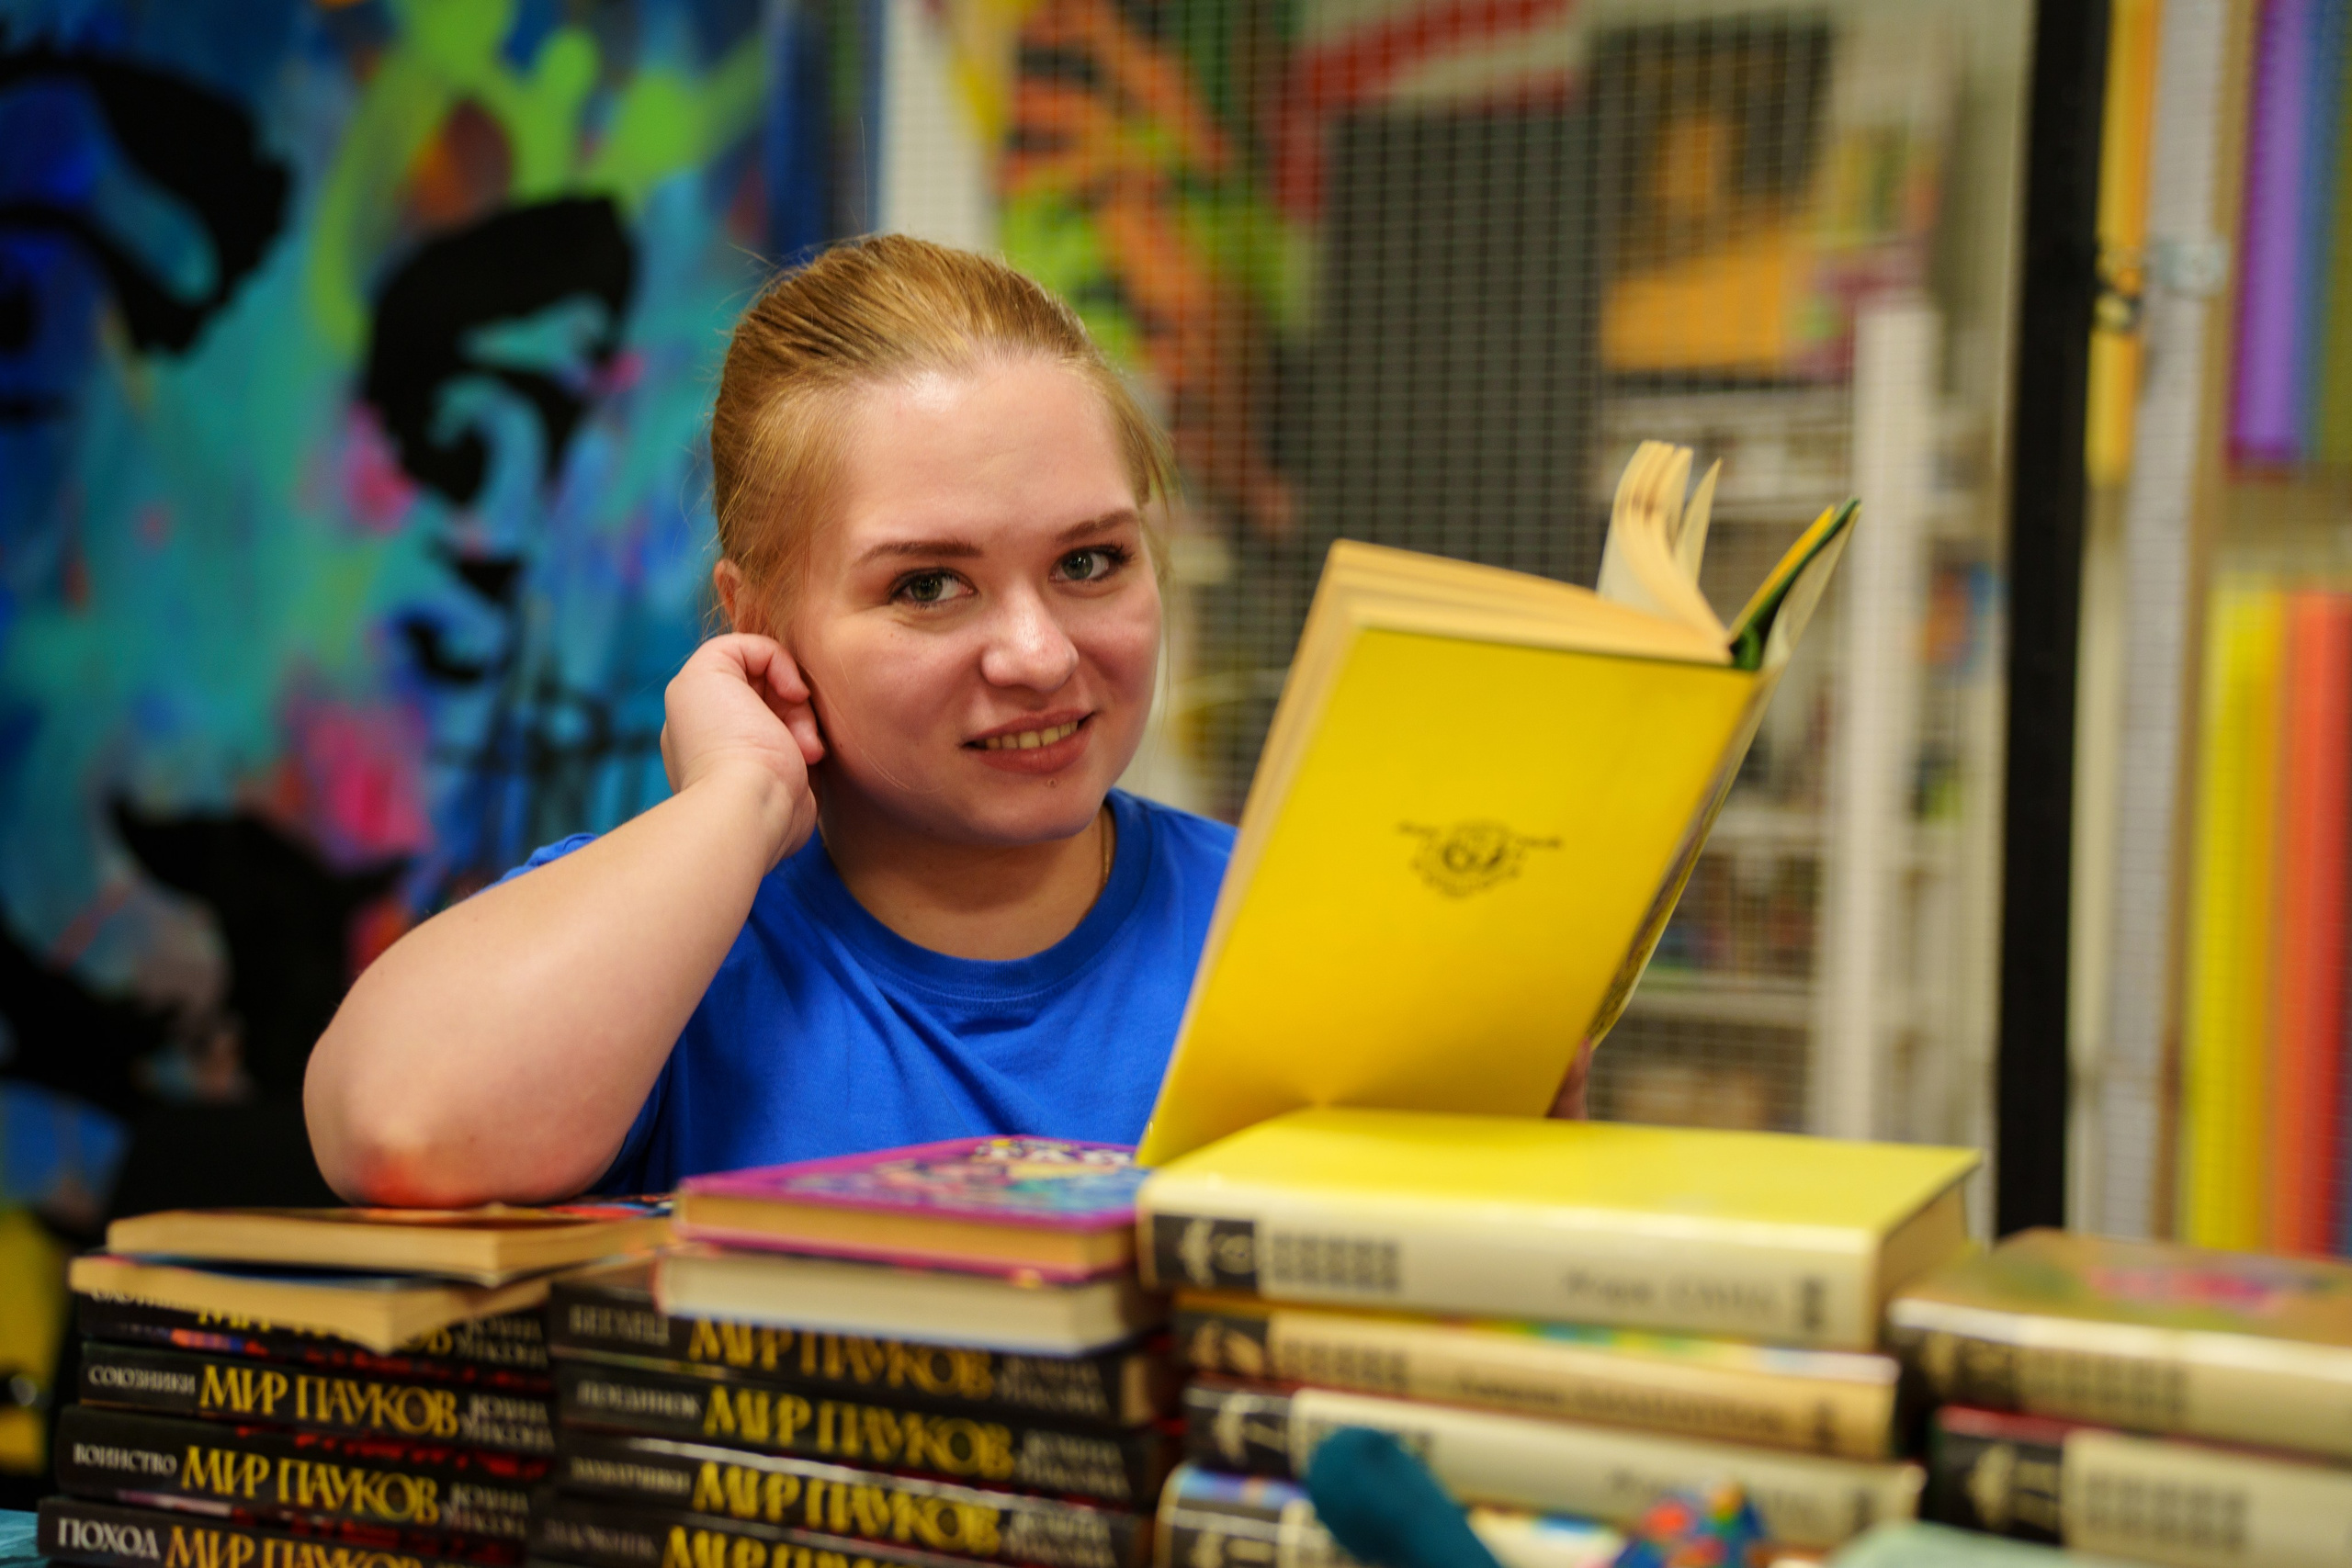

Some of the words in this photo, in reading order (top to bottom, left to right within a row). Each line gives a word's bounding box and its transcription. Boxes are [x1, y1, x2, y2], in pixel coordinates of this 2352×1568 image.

[198, 1363, 289, 1416] МИР
[295, 1373, 460, 1439] ПАУКОВ
[702, 1384, 813, 1445] МИР
[816, 1398, 1013, 1481] ПАУКОВ
[72, 1441, 179, 1478] ВОИНСТВО
[179, 1444, 272, 1499] МИР
[277, 1457, 441, 1527] ПАУКОВ
[691, 1461, 802, 1522] МИР
[804, 1476, 1002, 1556] ПАУКОВ
[57, 1516, 161, 1561] ПОХОД
[164, 1524, 257, 1568] МИР
